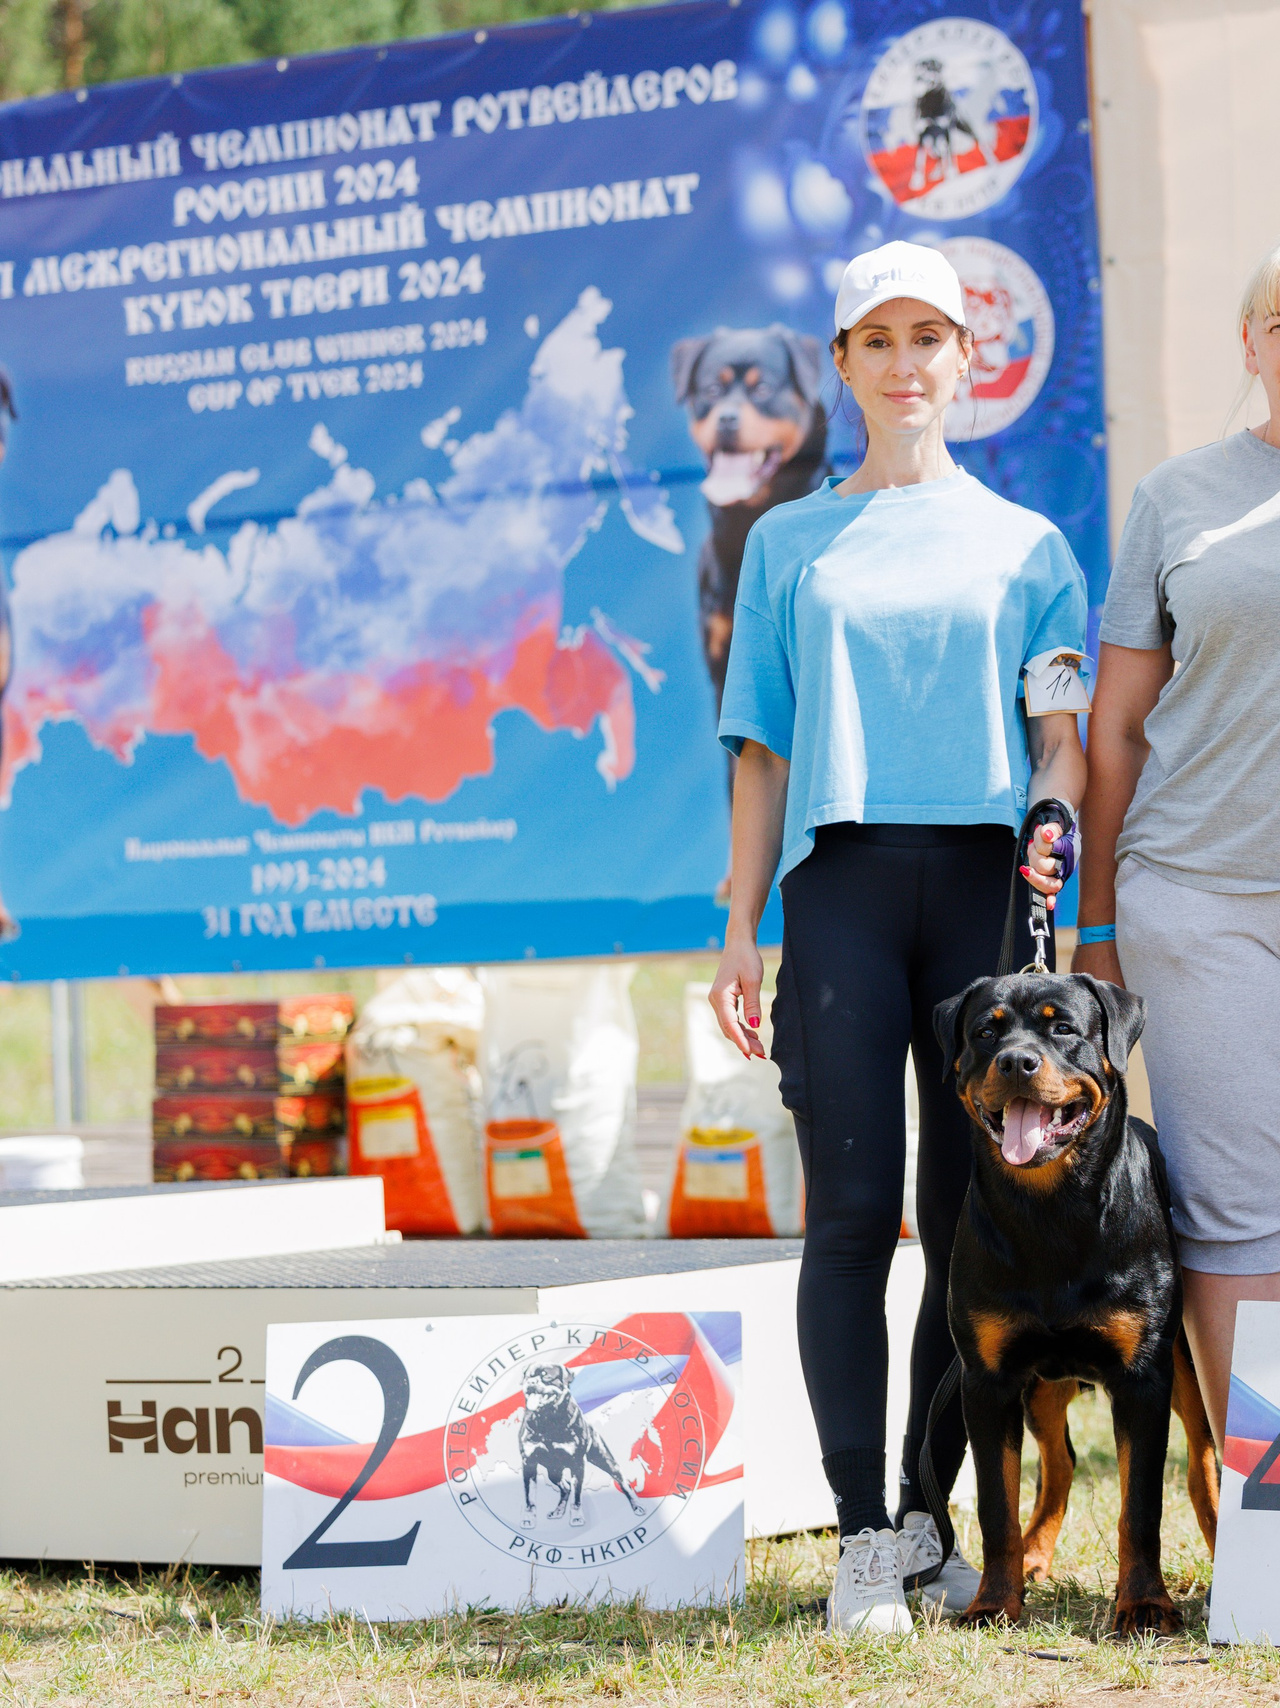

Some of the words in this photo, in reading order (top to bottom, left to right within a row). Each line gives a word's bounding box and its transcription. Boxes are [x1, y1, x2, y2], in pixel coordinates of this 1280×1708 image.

[0, 131, 182, 199] НАЛЬНЫЙ
[190, 101, 441, 171] ЧЕМПИОНАТ
[452, 60, 738, 138] РОТВЕЙЛЕРОВ
[172, 169, 326, 226] РОССИИ
[333, 157, 420, 206] 2024
[23, 203, 428, 297] МЕЖРЕГИОНАЛЬНЫЙ
[435, 172, 700, 244] ЧЕМПИОНАТ
[122, 283, 254, 336] КУБОК
[261, 265, 390, 319] ТВЕРИ
[397, 253, 486, 303] 2024
[125, 346, 237, 387] RUSSIAN
[240, 337, 312, 373] CLUB
[314, 324, 427, 364] WINNER
[429, 316, 489, 352] 2024
[187, 379, 243, 413] CUP
[246, 375, 283, 407] OF
[286, 366, 361, 402] TVER
[364, 360, 425, 394] 2024
[1045, 668, 1072, 701] 11
[251, 855, 387, 896] 1993-2024
[239, 900, 297, 938] ГОД
[302, 893, 439, 934] ВМЕСТЕ
[217, 1346, 244, 1383] 2
[106, 1400, 264, 1455] Han
[448, 1333, 546, 1507] РОТВЕЙЛЕР
[567, 1329, 653, 1367] КЛУБ
[659, 1371, 702, 1501] РОССИИ
[281, 1334, 422, 1571] 2
[508, 1526, 648, 1565] РКФ-НКПР
